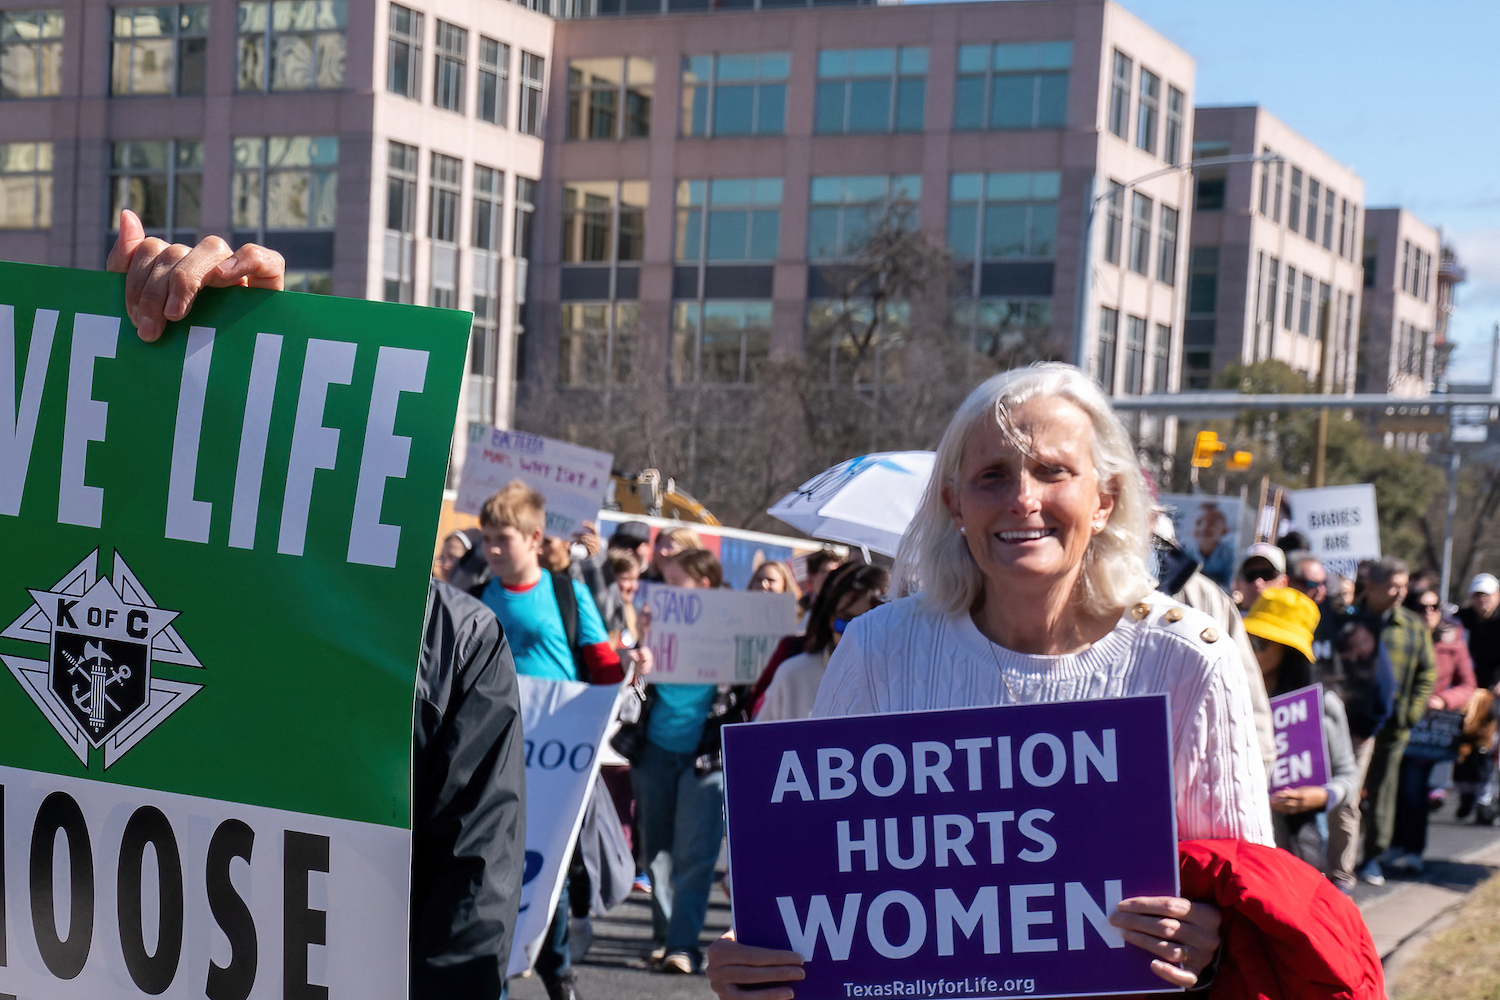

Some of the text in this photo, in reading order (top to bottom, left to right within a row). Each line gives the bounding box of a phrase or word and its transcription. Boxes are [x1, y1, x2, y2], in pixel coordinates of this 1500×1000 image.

[165, 326, 430, 568] LIFE
[56, 598, 149, 640] K OF C
[770, 728, 1118, 804] ABORTION
[837, 809, 1058, 872] HURTS
[776, 879, 1126, 963] WOMEN
[843, 976, 1036, 999] TexasRallyforLife.org
